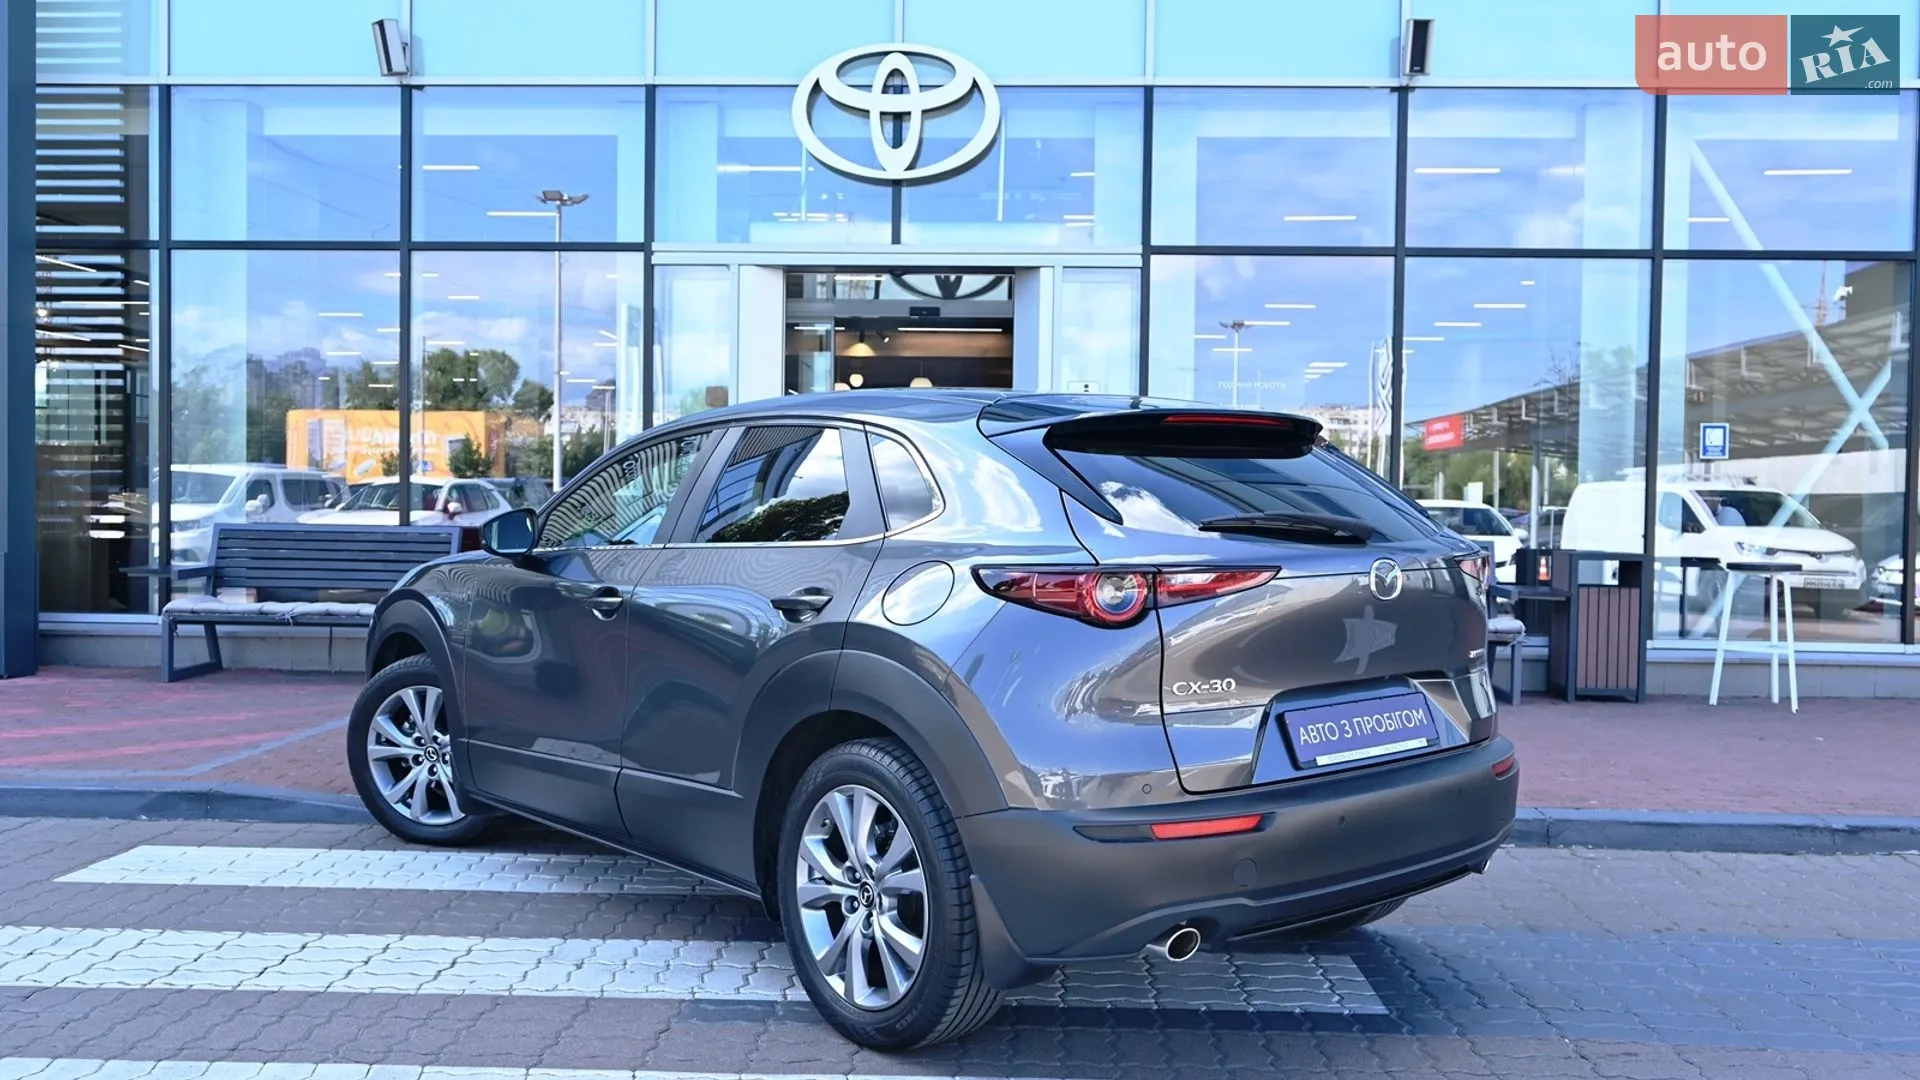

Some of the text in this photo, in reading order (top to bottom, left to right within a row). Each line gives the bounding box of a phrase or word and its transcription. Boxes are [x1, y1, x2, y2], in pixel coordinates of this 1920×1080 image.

[1172, 677, 1236, 696] CX-30
[1299, 722, 1340, 746] АВТО
[1353, 707, 1428, 737] ПРОБІГОМ
